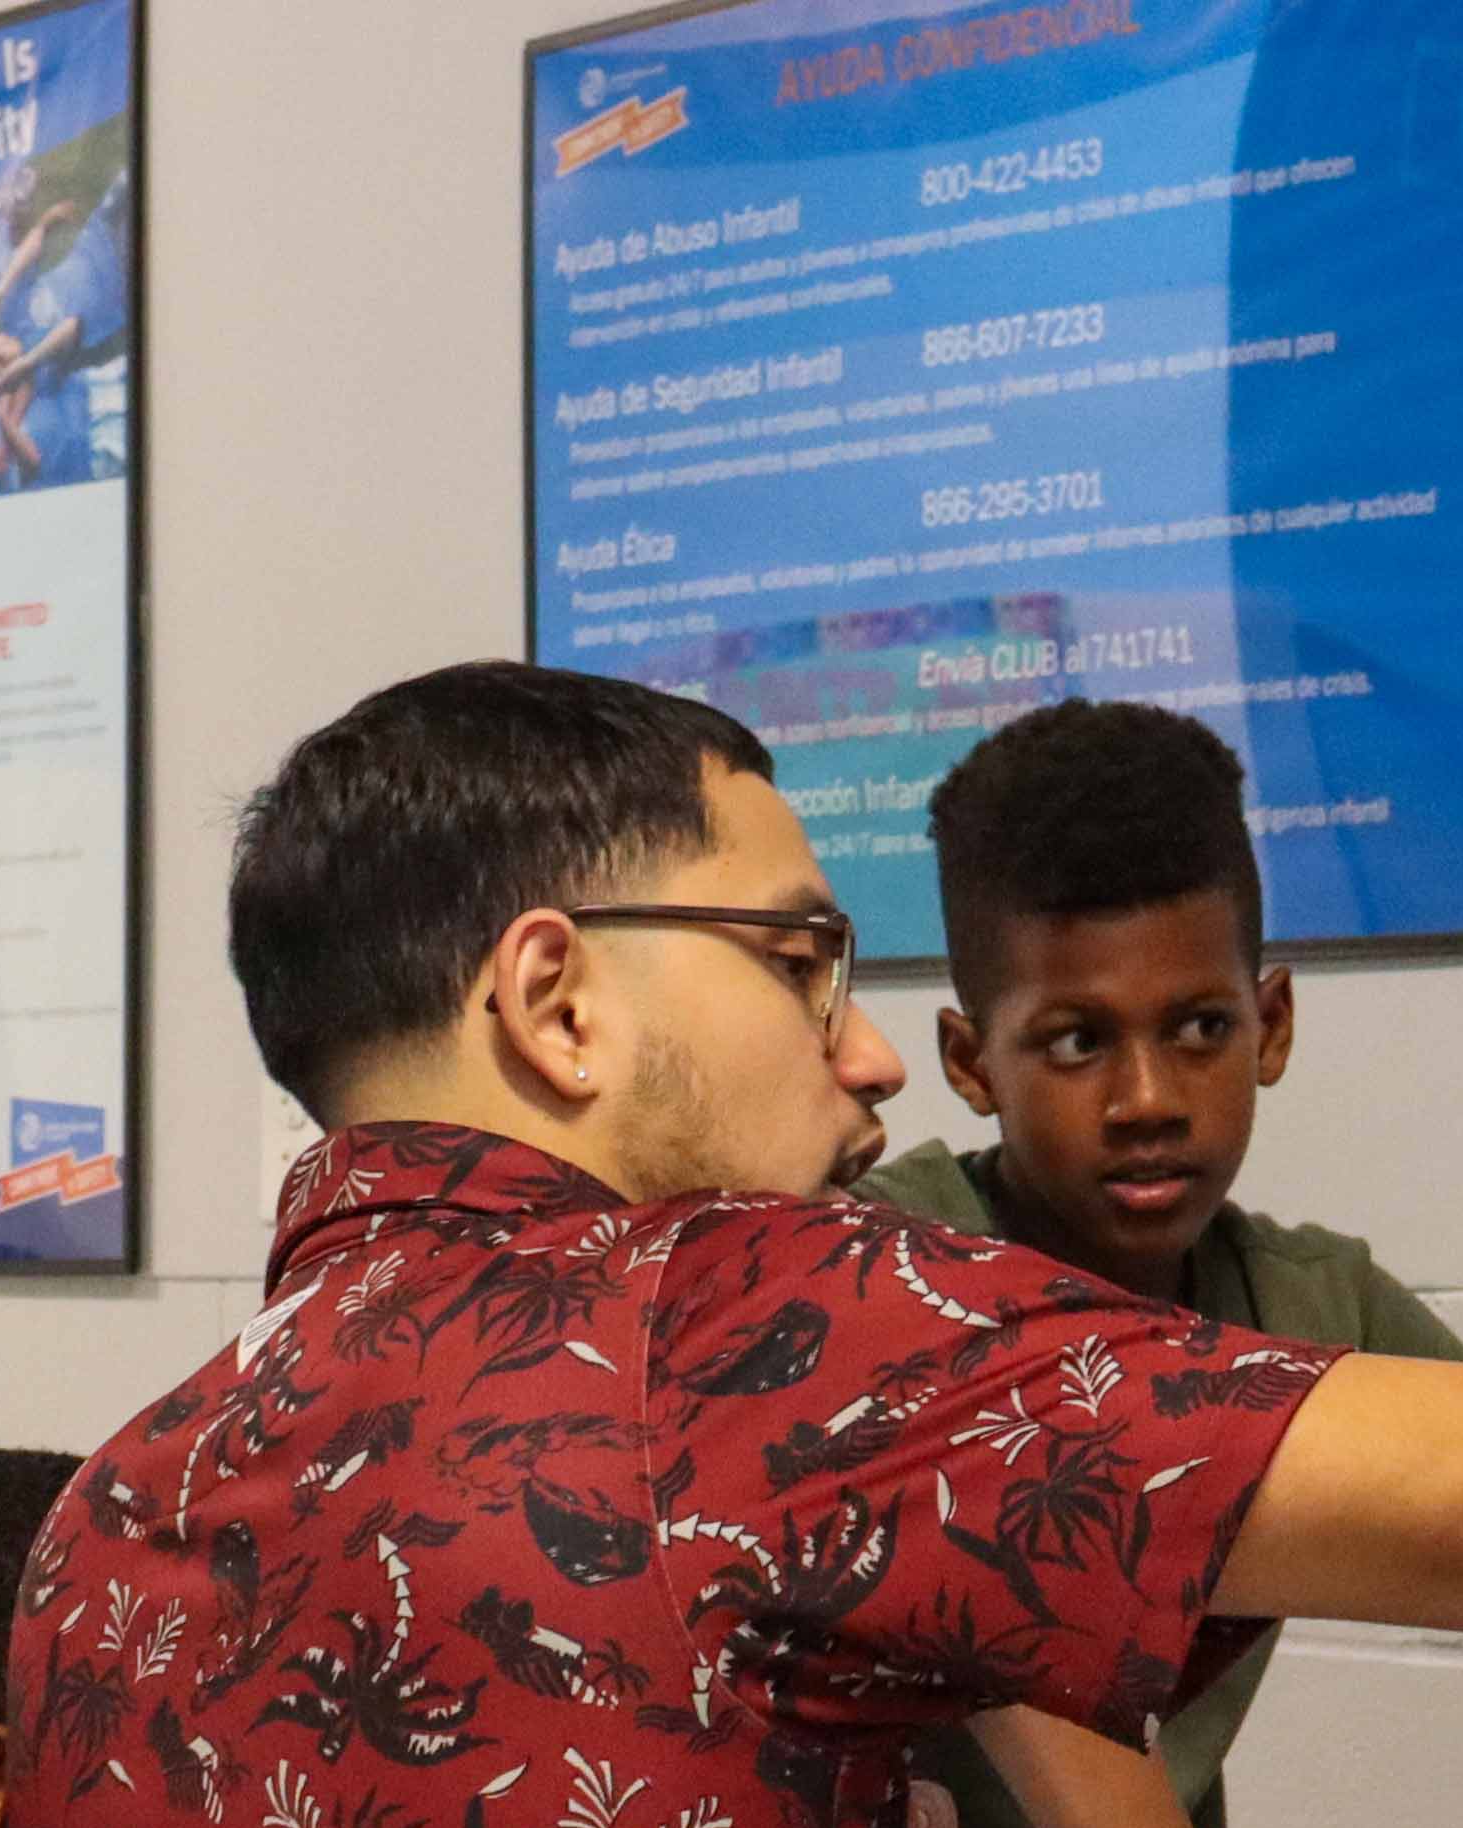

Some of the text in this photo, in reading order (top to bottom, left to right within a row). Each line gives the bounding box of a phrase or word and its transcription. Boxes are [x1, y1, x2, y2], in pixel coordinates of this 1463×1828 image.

[2, 37, 37, 89] Is
[774, 0, 1143, 107] AYUDA CONFIDENCIAL
[921, 138, 1103, 207] 800-422-4453
[554, 194, 800, 283] Ayuda de Abuso Infantil
[923, 304, 1104, 366] 866-607-7233
[555, 346, 842, 432] Ayuda de Seguridad Infantil
[922, 471, 1104, 528] 866-295-3701
[556, 521, 677, 580] Ayuda Ética
[917, 625, 1195, 687] Envía CLUB al 741741
